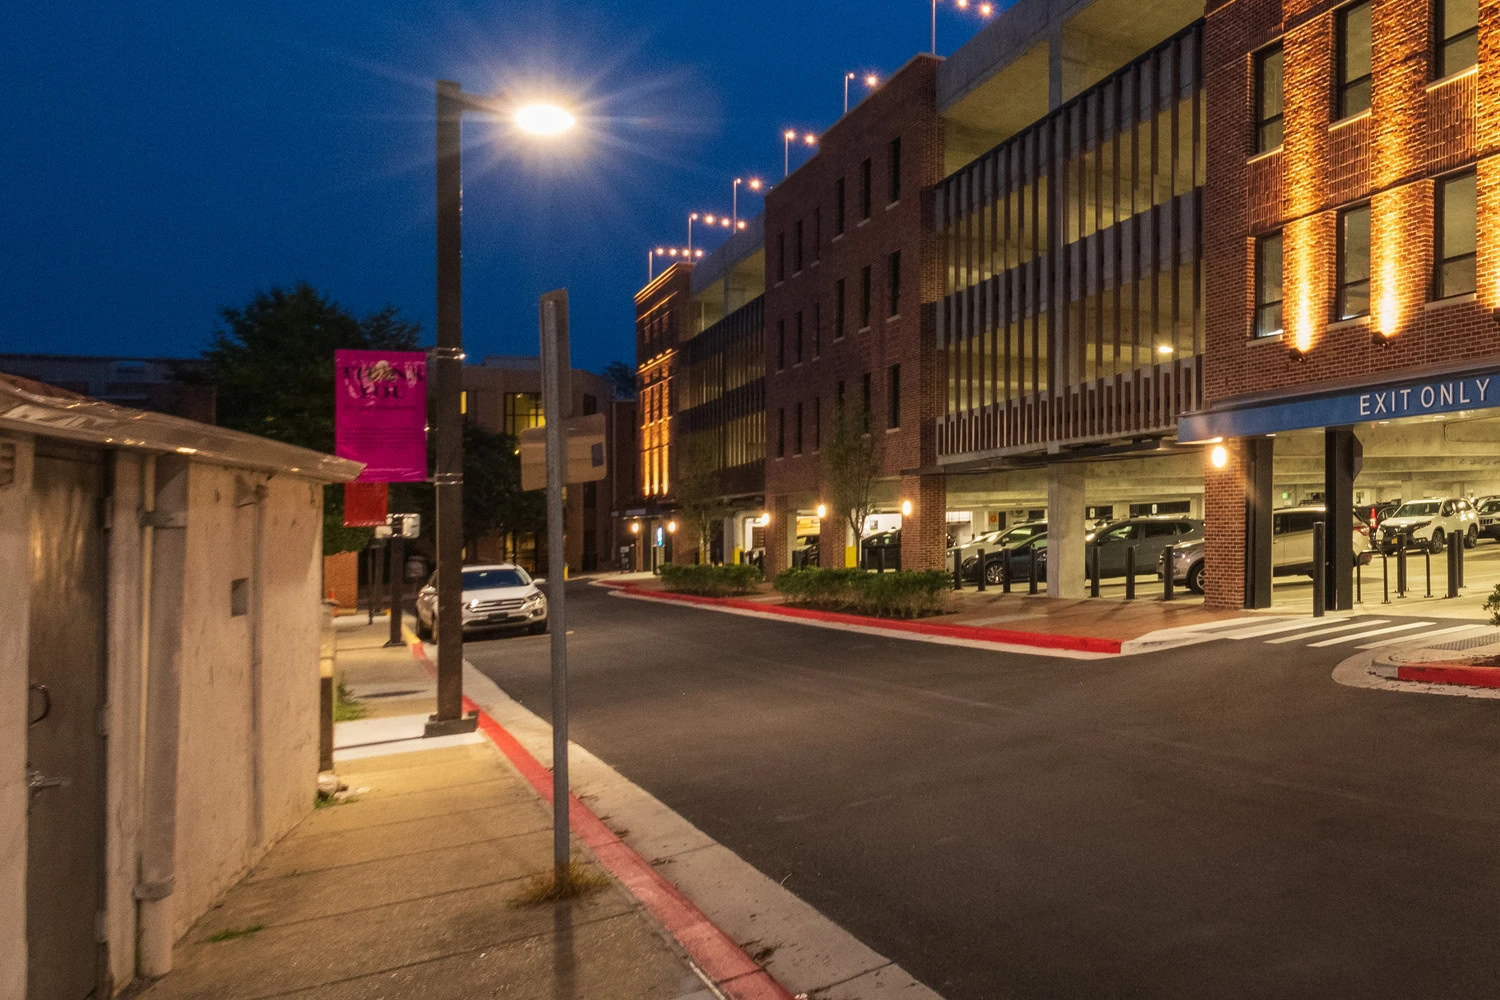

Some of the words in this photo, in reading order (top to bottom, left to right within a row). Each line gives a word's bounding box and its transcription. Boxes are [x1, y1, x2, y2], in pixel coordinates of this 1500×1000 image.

[341, 365, 424, 382] THNK
[1360, 389, 1411, 416] EXIT
[1420, 378, 1490, 408] ONLY
